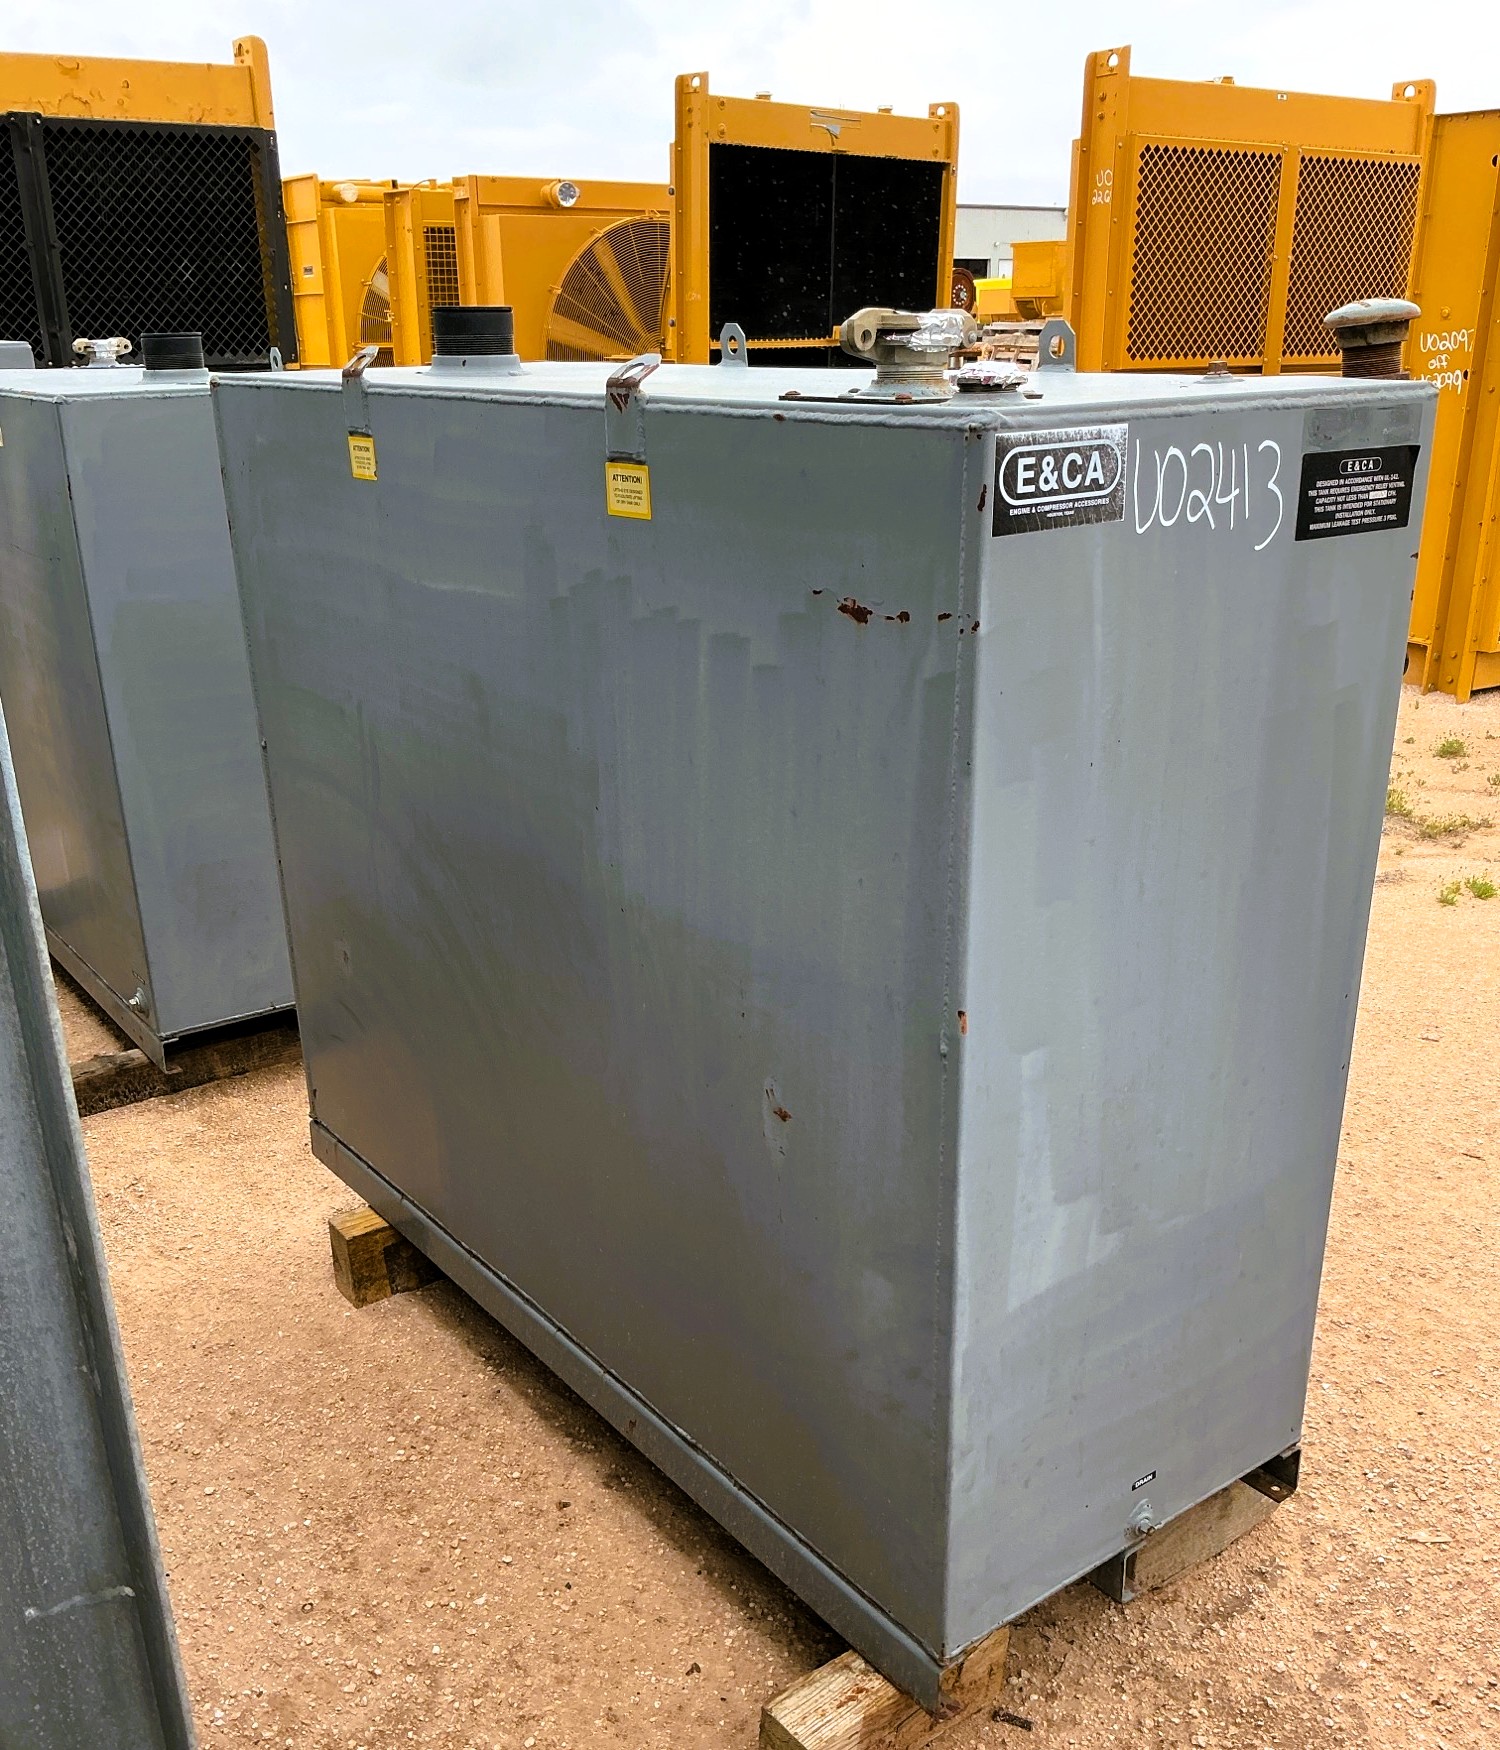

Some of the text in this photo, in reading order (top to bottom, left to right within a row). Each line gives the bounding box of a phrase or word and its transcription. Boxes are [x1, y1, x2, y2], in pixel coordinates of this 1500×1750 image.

[1347, 459, 1374, 472] E&CA
[1017, 451, 1104, 494] E&CA
[612, 474, 643, 484] ATTENTION!
[1316, 479, 1338, 487] DESIGNED
[1345, 476, 1373, 484] ACCORDANCE
[1330, 487, 1350, 495] REQUIRES
[1350, 484, 1375, 492] EMERGENCY
[1010, 506, 1030, 516] ENGINE
[1037, 501, 1073, 512] COMPRESSOR
[1074, 498, 1109, 508] ACCESSORIES
[1342, 502, 1363, 510] INTENDED
[1373, 498, 1397, 506] STATIONARY
[1335, 511, 1363, 519] INSTALLATION
[1309, 522, 1330, 530] MAXIMUM
[1331, 519, 1350, 527] LEAKAGE
[1361, 516, 1383, 524] PRESSURE
[1135, 1474, 1153, 1488] DRAIN
